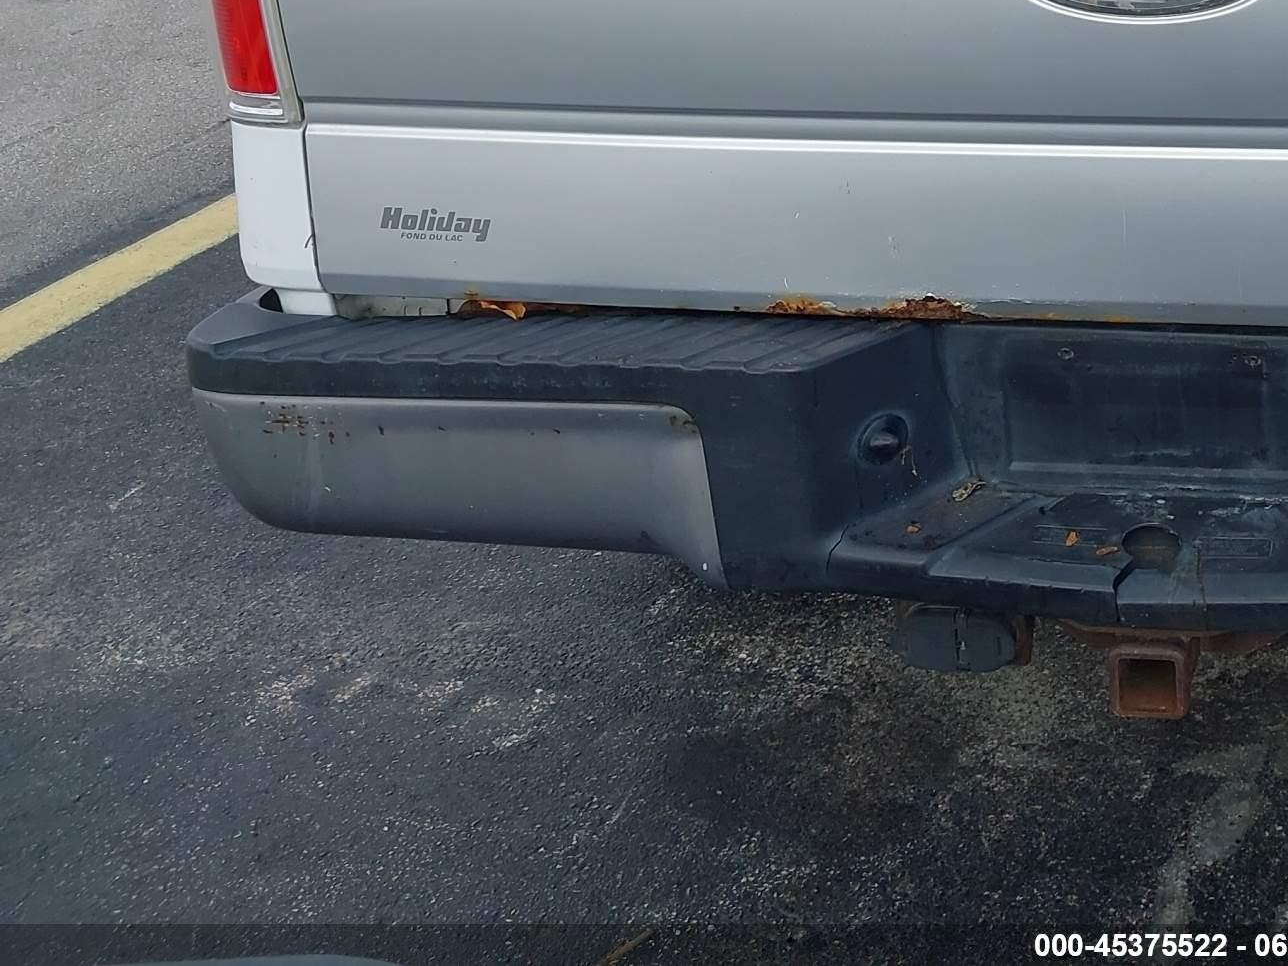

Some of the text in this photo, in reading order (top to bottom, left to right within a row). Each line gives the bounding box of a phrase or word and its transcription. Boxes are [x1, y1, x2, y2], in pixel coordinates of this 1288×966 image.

[380, 206, 491, 242] Holiday
[401, 232, 463, 242] FOND DU LAC
